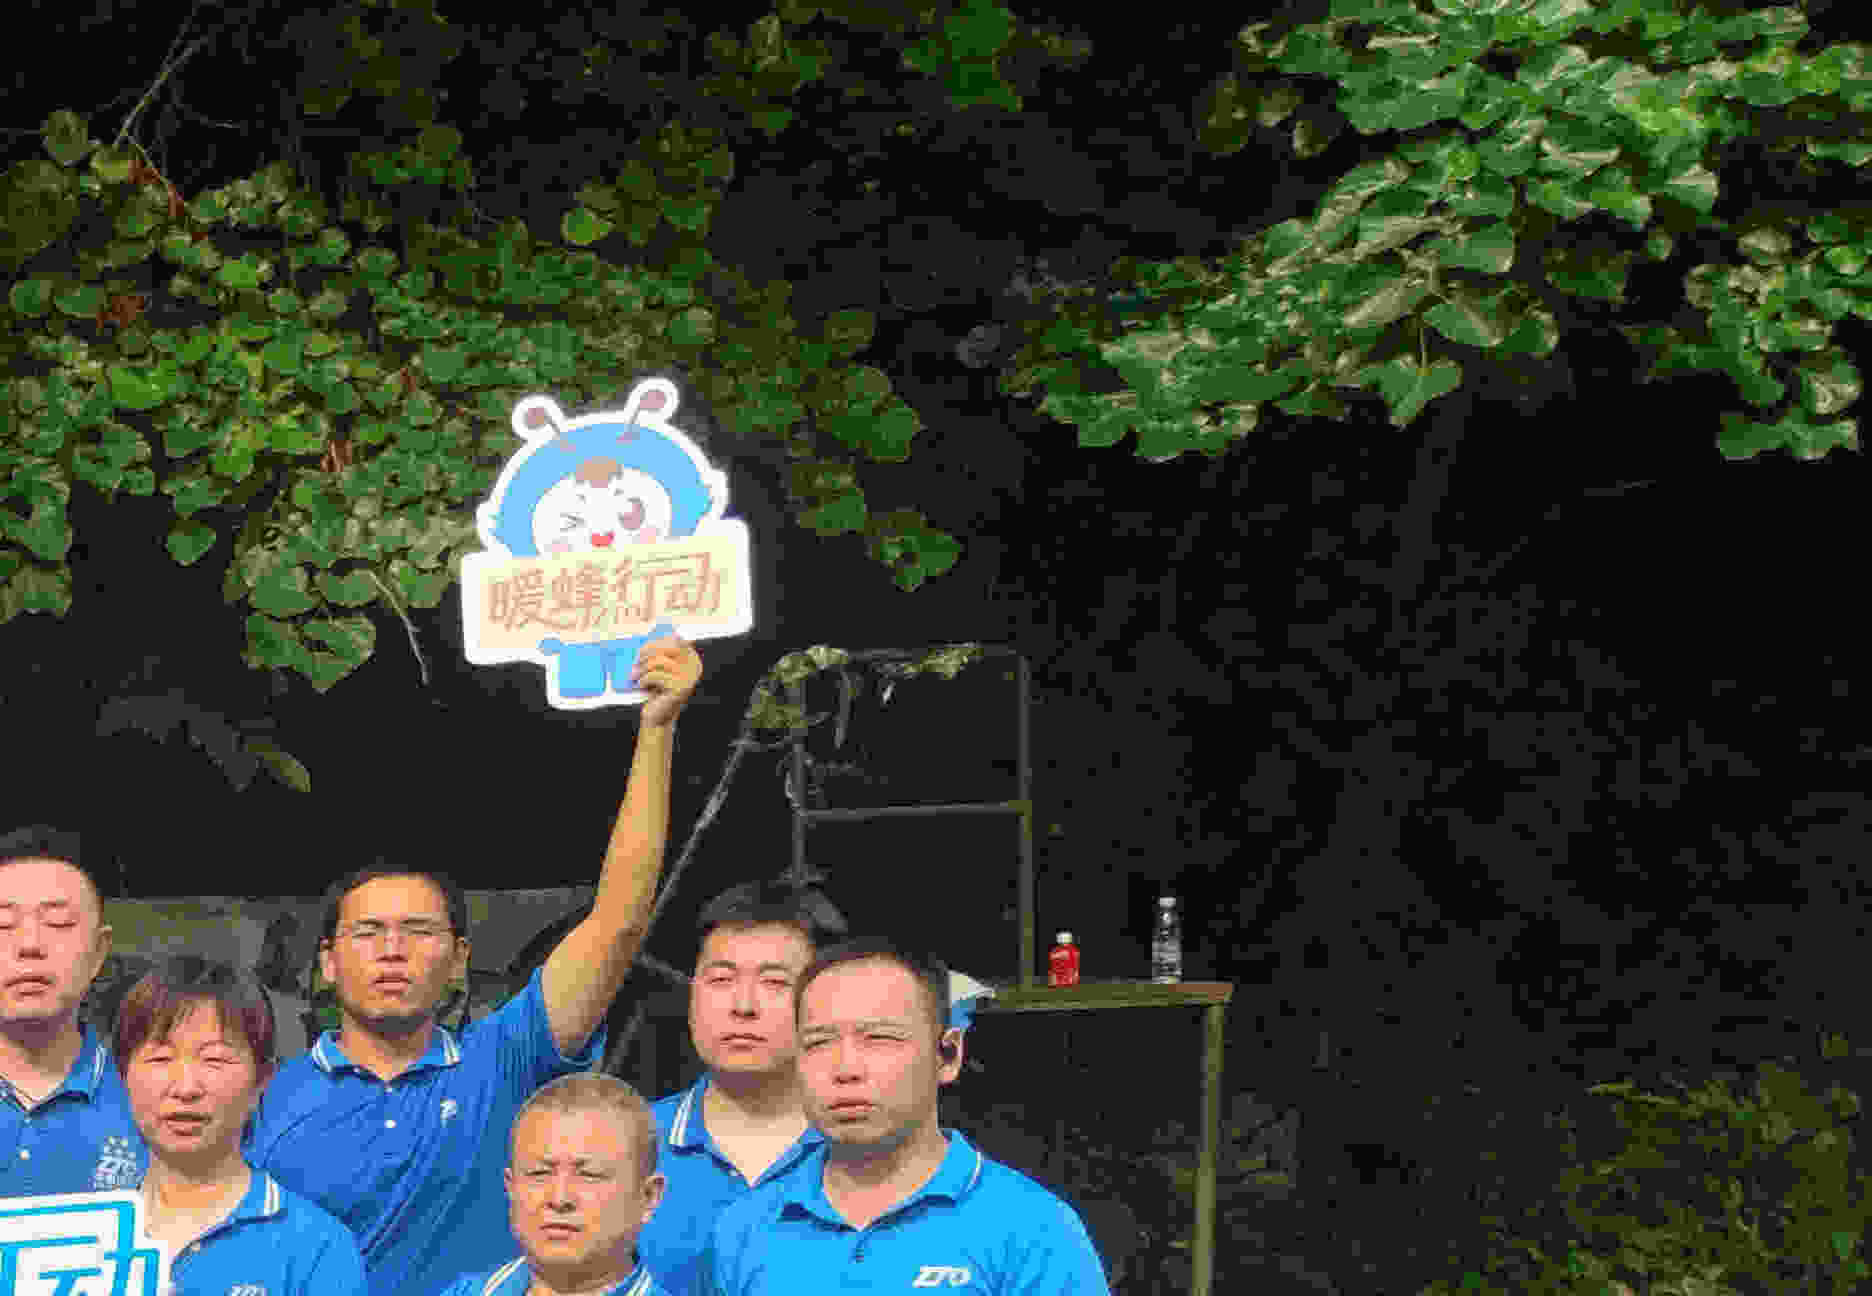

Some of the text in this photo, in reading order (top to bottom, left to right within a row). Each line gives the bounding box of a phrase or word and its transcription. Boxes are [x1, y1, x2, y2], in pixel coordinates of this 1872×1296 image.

[487, 551, 722, 632] 暖蜂行动
[913, 1264, 970, 1288] ZTO
